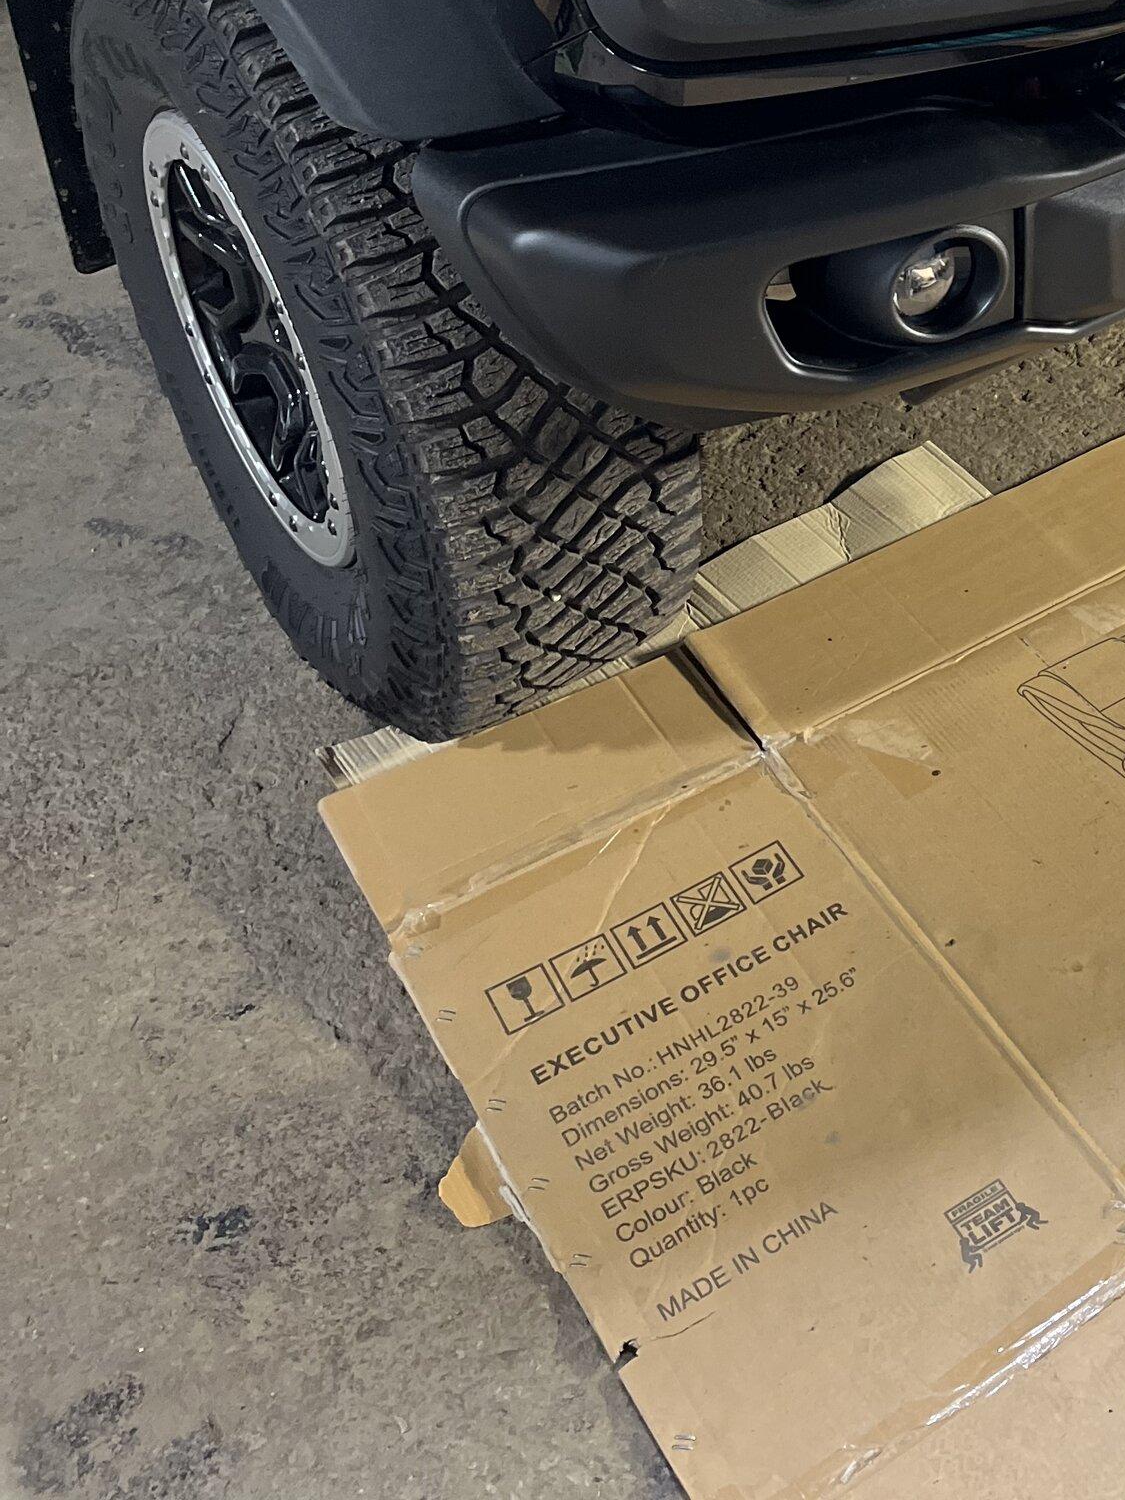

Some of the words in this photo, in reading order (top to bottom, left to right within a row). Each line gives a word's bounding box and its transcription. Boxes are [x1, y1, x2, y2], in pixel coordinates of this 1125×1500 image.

[530, 996, 679, 1086] EXECUTIVE
[680, 945, 772, 1003] OFFICE
[772, 902, 849, 952] CHAIR
[548, 1083, 611, 1125] Batch
[561, 1069, 689, 1148] Dimensions:
[690, 1035, 738, 1075] 29.5"
[745, 1028, 761, 1044] x
[762, 1005, 790, 1032] 15"
[796, 1000, 812, 1015] x
[811, 966, 857, 1006] 25.6"
[574, 1138, 616, 1172] Net
[614, 1095, 696, 1146] Weight:
[697, 1065, 742, 1100] 36.1
[744, 1049, 777, 1073] lbs
[589, 1150, 654, 1193] Gross
[653, 1103, 734, 1155] Weight:
[738, 1071, 778, 1107] 40.7
[781, 1057, 815, 1081] lbs
[600, 1150, 706, 1220] ERPSKU:
[706, 1079, 834, 1159] 2822-Black
[615, 1190, 694, 1243] Colour:
[696, 1153, 759, 1195] Black
[629, 1204, 726, 1269] Quantity:
[729, 1178, 770, 1207] 1pc
[950, 1185, 999, 1218] FRAGILE
[960, 1197, 1011, 1232] TEAM
[968, 1206, 1016, 1245] LIFT
[656, 1265, 732, 1322] MADE
[732, 1246, 760, 1275] IN
[762, 1201, 839, 1254] CHINA
